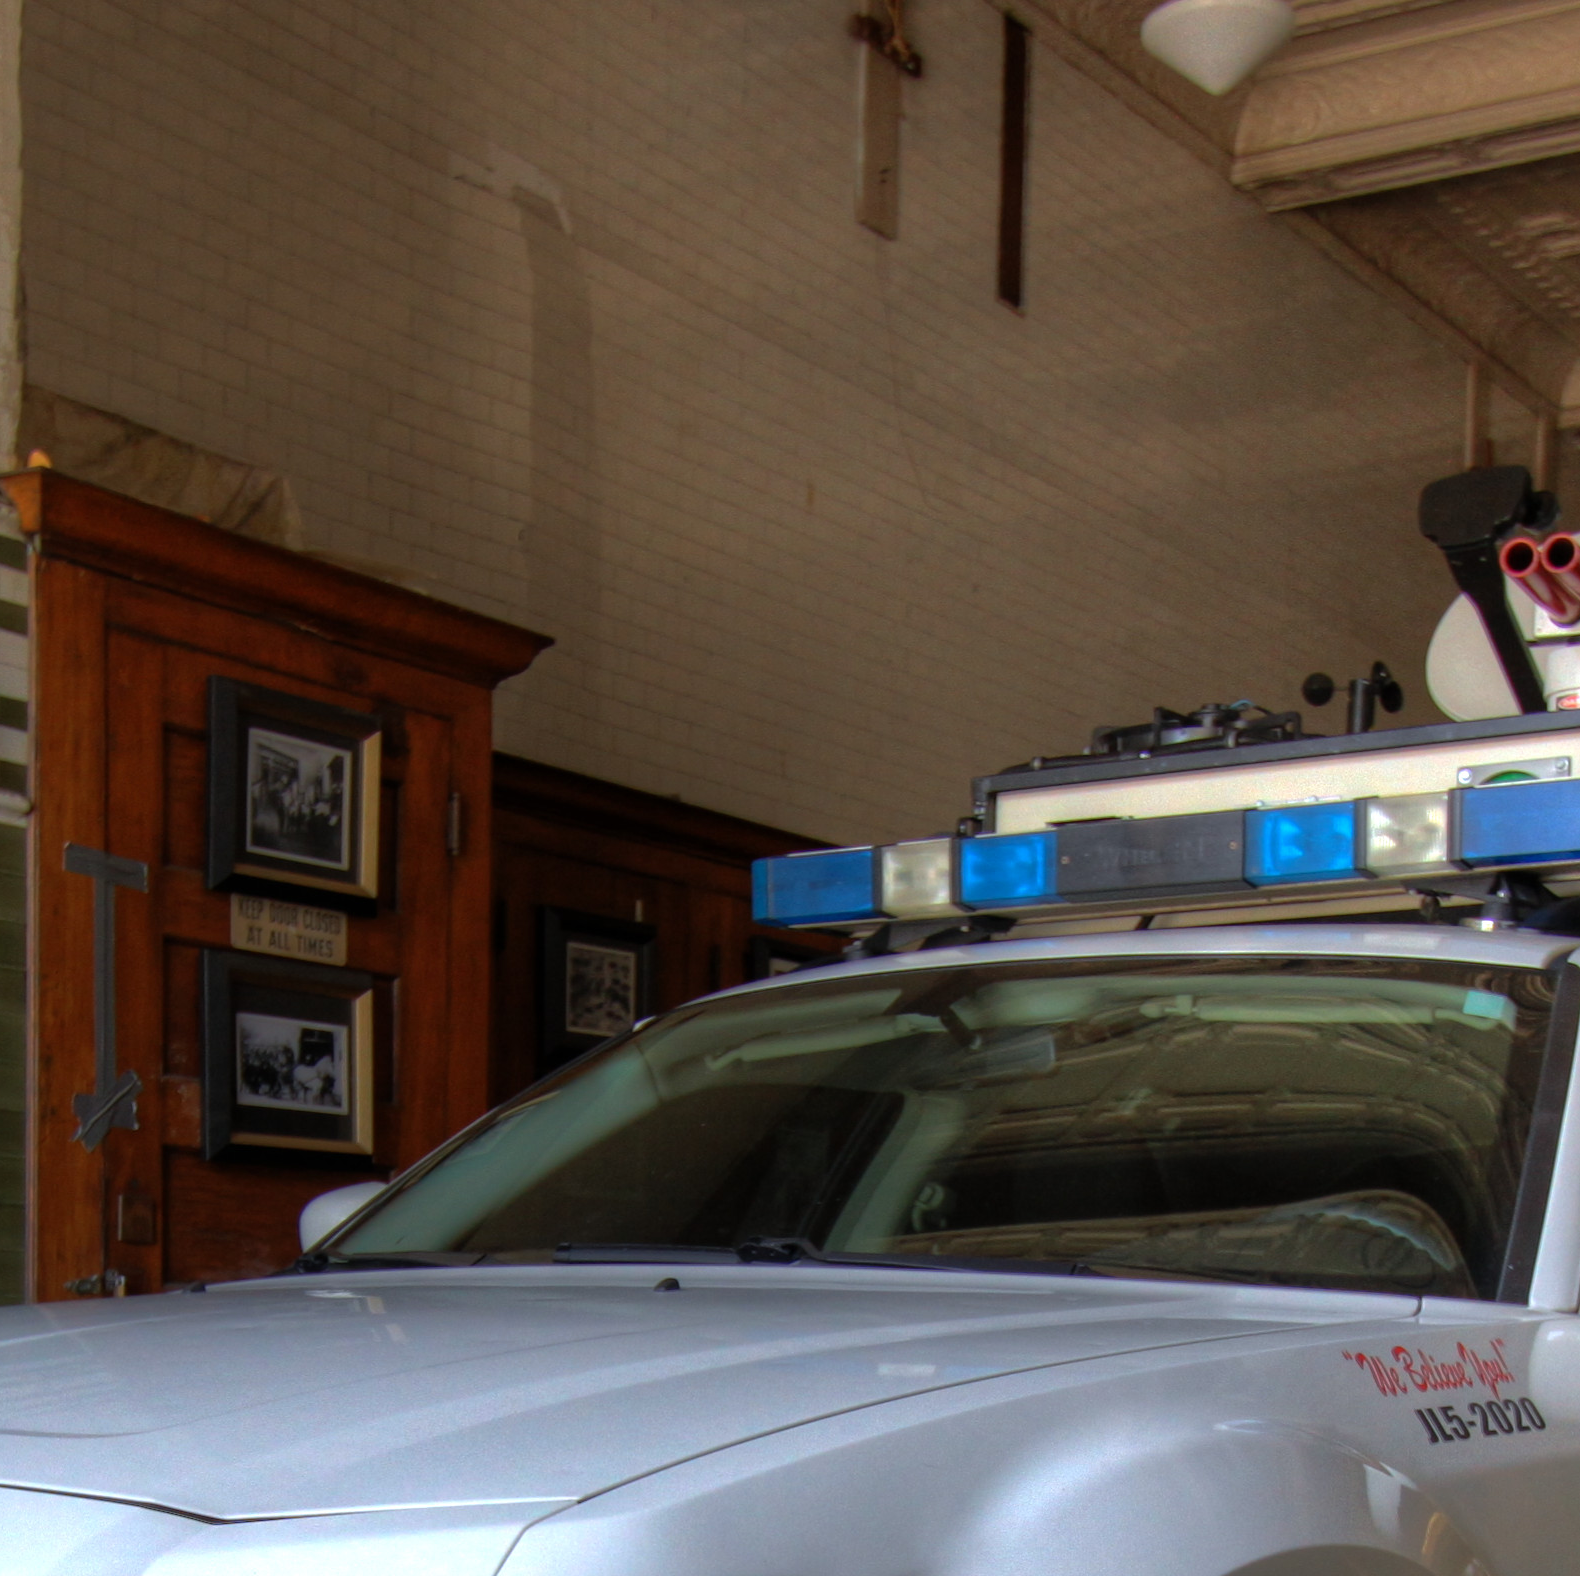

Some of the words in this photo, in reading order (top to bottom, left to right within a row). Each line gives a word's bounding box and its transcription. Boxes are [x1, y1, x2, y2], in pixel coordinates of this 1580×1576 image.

[238, 896, 263, 919] KEEP
[269, 901, 299, 926] DOOR
[303, 909, 341, 935] CLOSED
[246, 927, 262, 945] AT
[269, 930, 291, 951] ALL
[297, 935, 333, 958] TIMES
[1392, 1346, 1473, 1392] Believe
